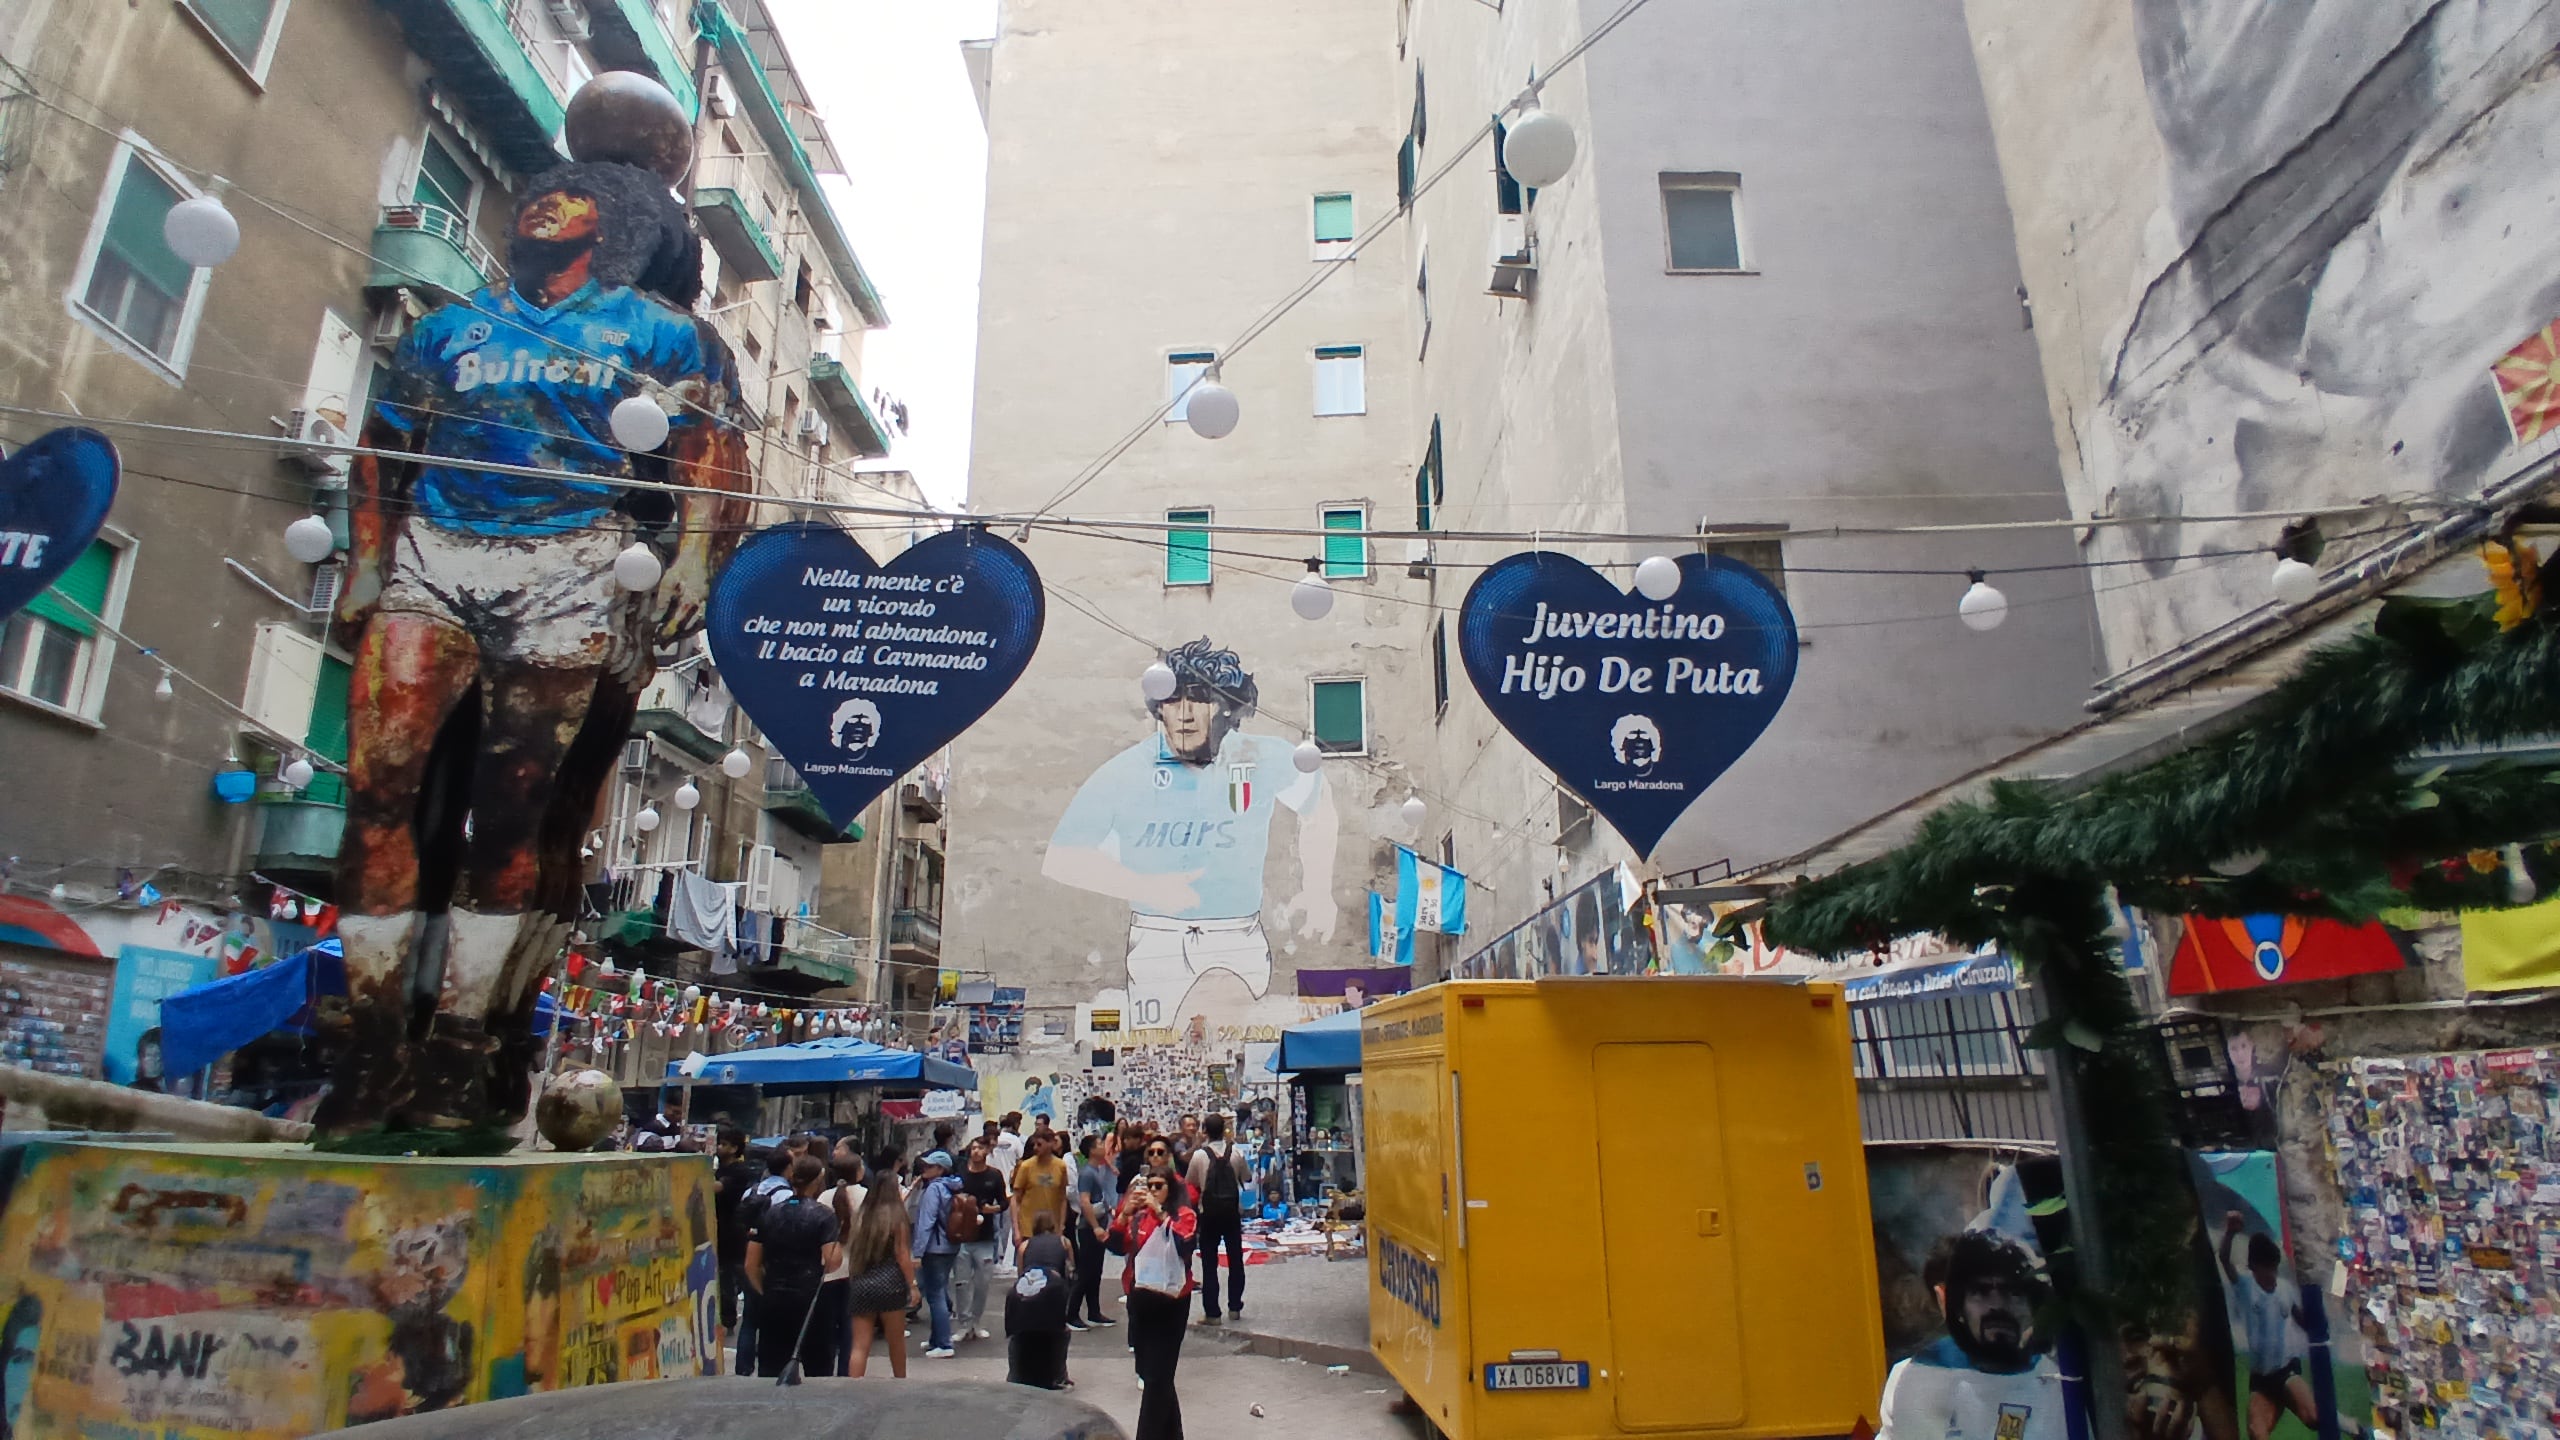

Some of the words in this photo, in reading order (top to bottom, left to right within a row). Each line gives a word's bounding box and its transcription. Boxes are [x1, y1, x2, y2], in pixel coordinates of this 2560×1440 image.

[0, 531, 51, 569] TE
[802, 567, 860, 589] Nella
[865, 572, 931, 592] mente
[936, 574, 964, 594] c'è
[823, 598, 851, 613] un
[858, 596, 936, 617] ricordo
[744, 616, 779, 635] che
[785, 622, 826, 637] non
[832, 620, 859, 639] mi
[1522, 602, 1726, 644] Juventino
[759, 640, 776, 660] Il
[781, 641, 837, 663] bacio
[842, 645, 864, 664] di
[873, 645, 988, 671] Carmando
[799, 673, 815, 687] a
[823, 671, 939, 695] Maradona
[1500, 652, 1586, 700] Hijo
[1598, 656, 1653, 694] De
[1665, 657, 1763, 695] Puta
[804, 762, 836, 775] Largo
[839, 764, 893, 777] Maradona
[1594, 779, 1626, 791] Largo
[1628, 780, 1684, 791] Maradona
[1135, 998, 1161, 1026] 10
[1378, 1232, 1441, 1330] CHIOSCO
[1498, 1364, 1518, 1387] XA
[1524, 1363, 1577, 1386] 068VC
